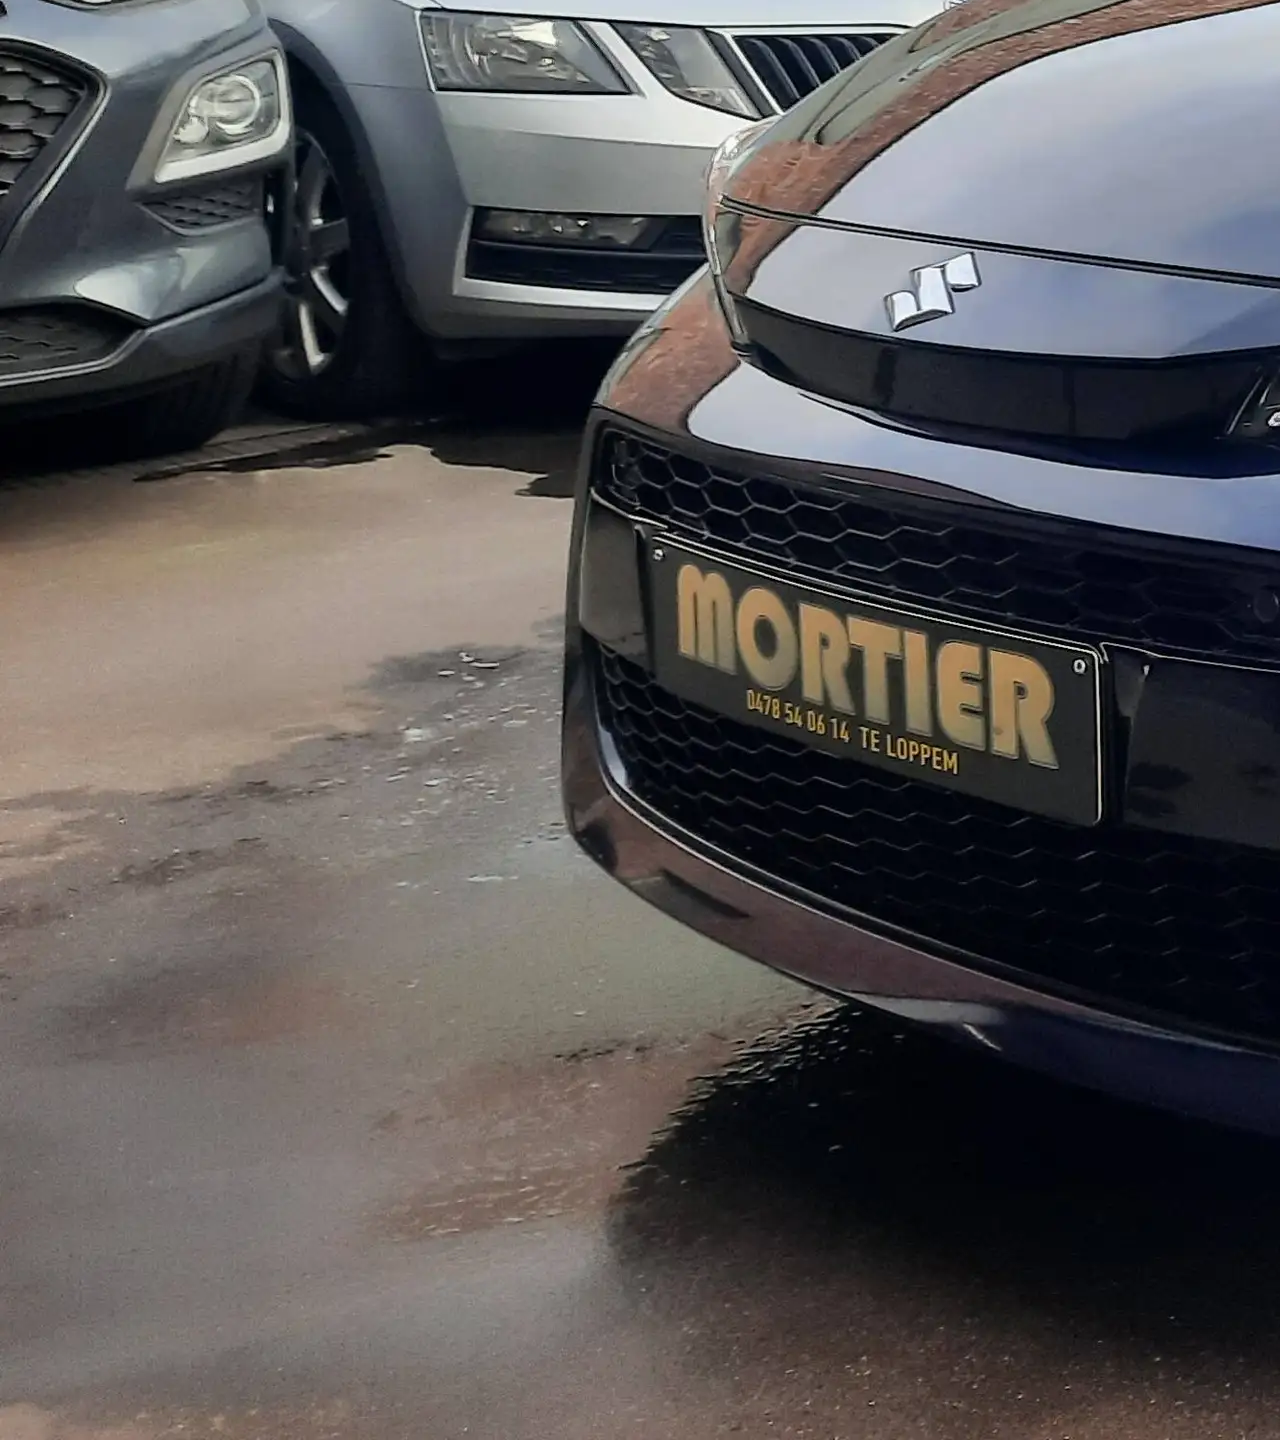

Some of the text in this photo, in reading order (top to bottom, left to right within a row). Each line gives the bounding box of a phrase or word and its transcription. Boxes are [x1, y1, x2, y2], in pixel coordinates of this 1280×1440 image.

[677, 563, 1059, 770] MORTIER
[745, 688, 959, 776] 0478 54 06 14 TE LOPPEM
